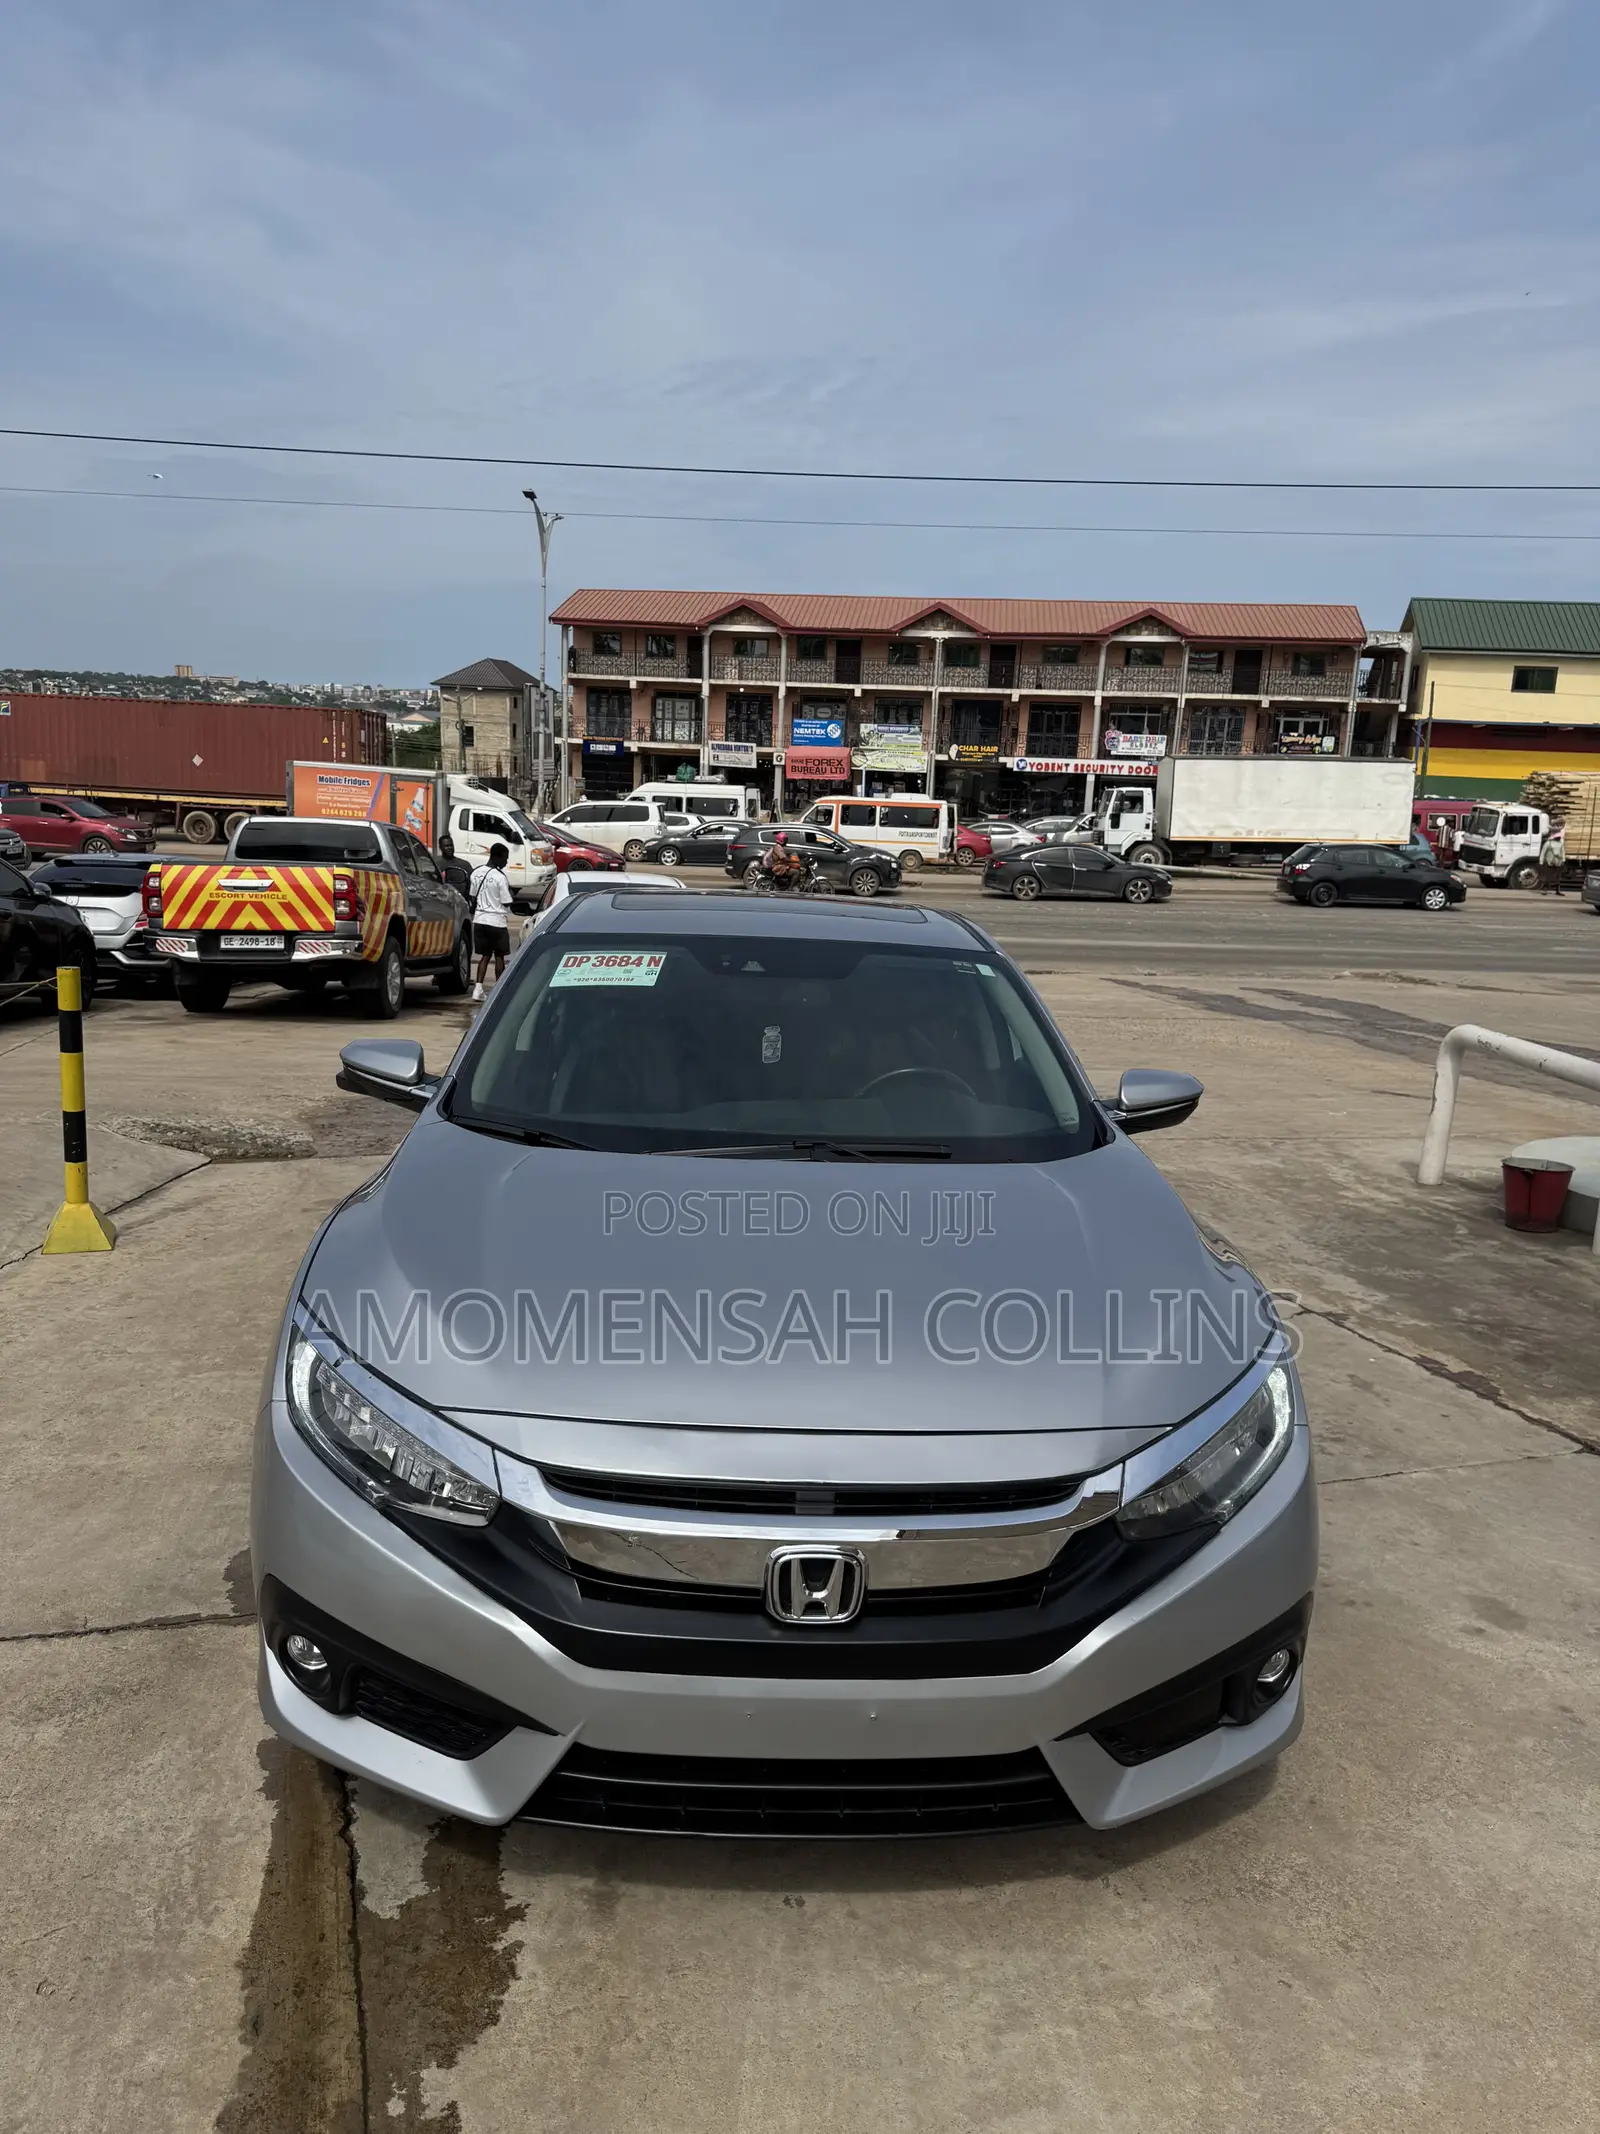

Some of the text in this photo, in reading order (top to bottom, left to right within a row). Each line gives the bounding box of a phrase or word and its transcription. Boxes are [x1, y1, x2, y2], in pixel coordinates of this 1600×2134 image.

[980, 745, 999, 753] HAIR
[805, 758, 844, 766] FOREX
[790, 765, 827, 774] BUREAU
[1028, 762, 1071, 772] YOBENT
[1073, 763, 1125, 774] SECURITY
[318, 775, 343, 784] Mobile
[563, 955, 663, 968] DP 3684 N
